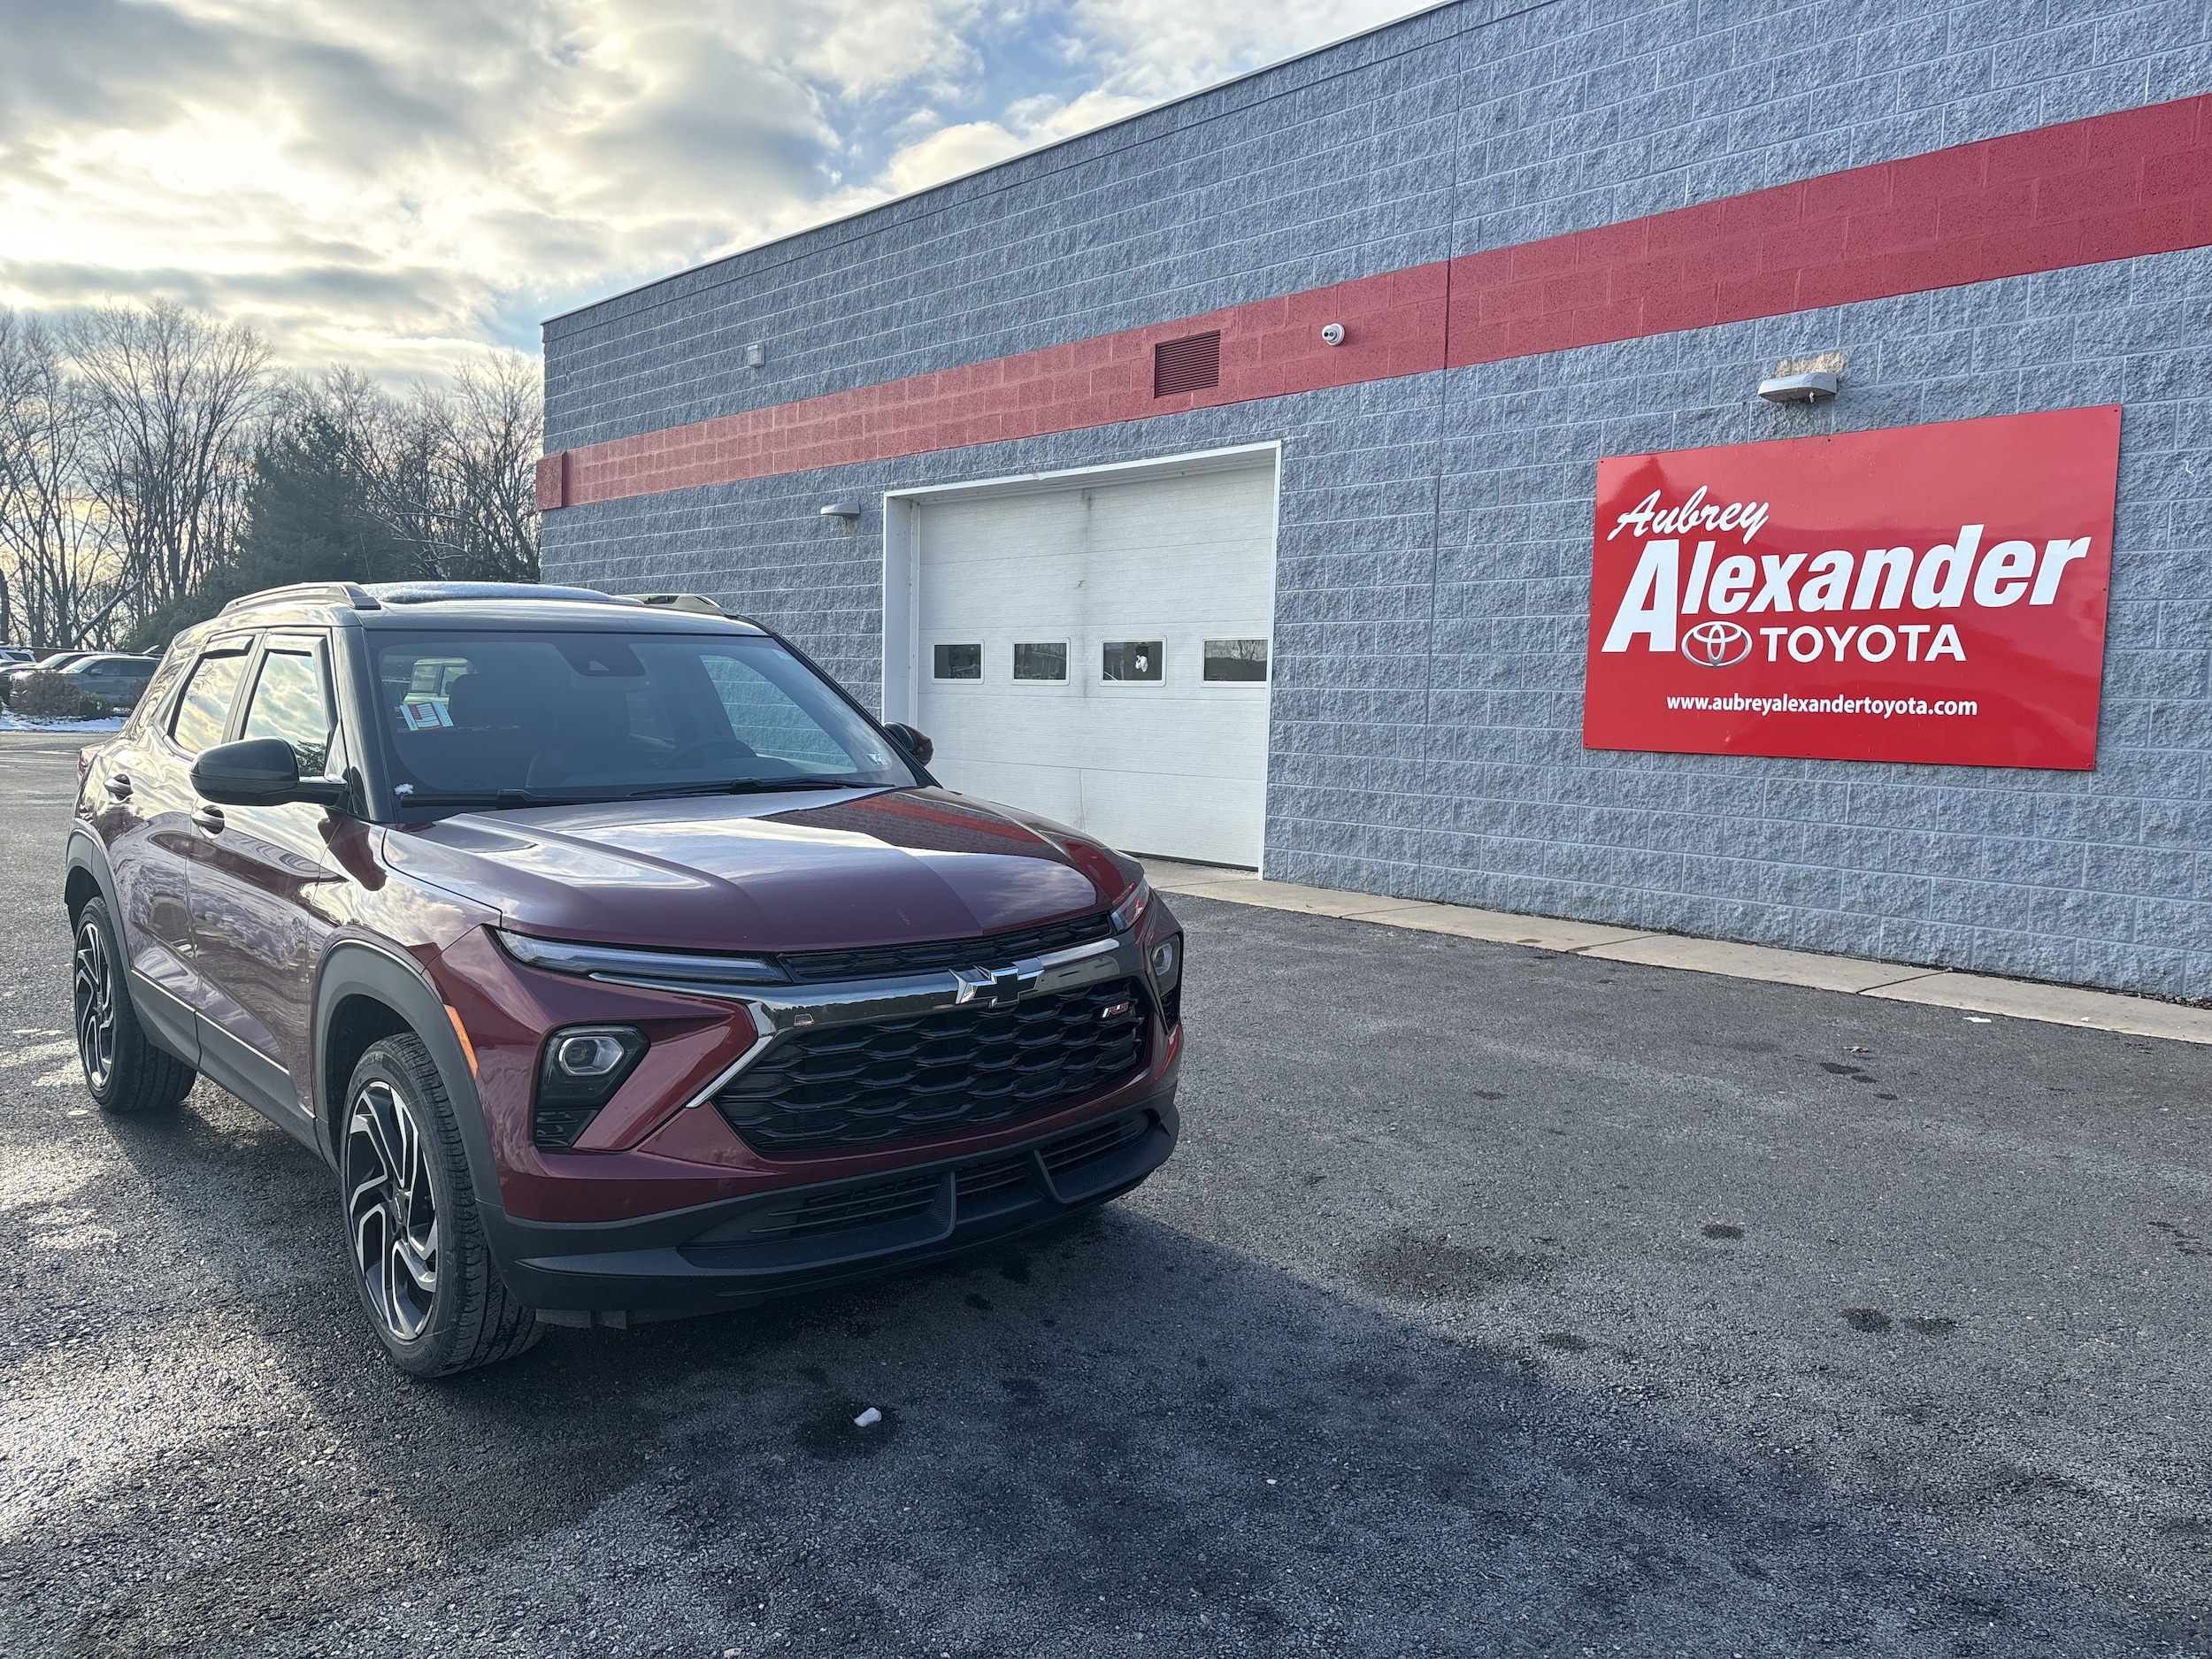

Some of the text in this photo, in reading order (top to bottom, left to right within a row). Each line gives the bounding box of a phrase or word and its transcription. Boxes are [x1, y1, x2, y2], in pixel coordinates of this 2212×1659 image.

[1607, 484, 1770, 544] Aubrey
[1601, 525, 2092, 653] Alexander
[1760, 625, 1967, 662] TOYOTA
[1667, 693, 1978, 718] www.aubreyalexandertoyota.com
